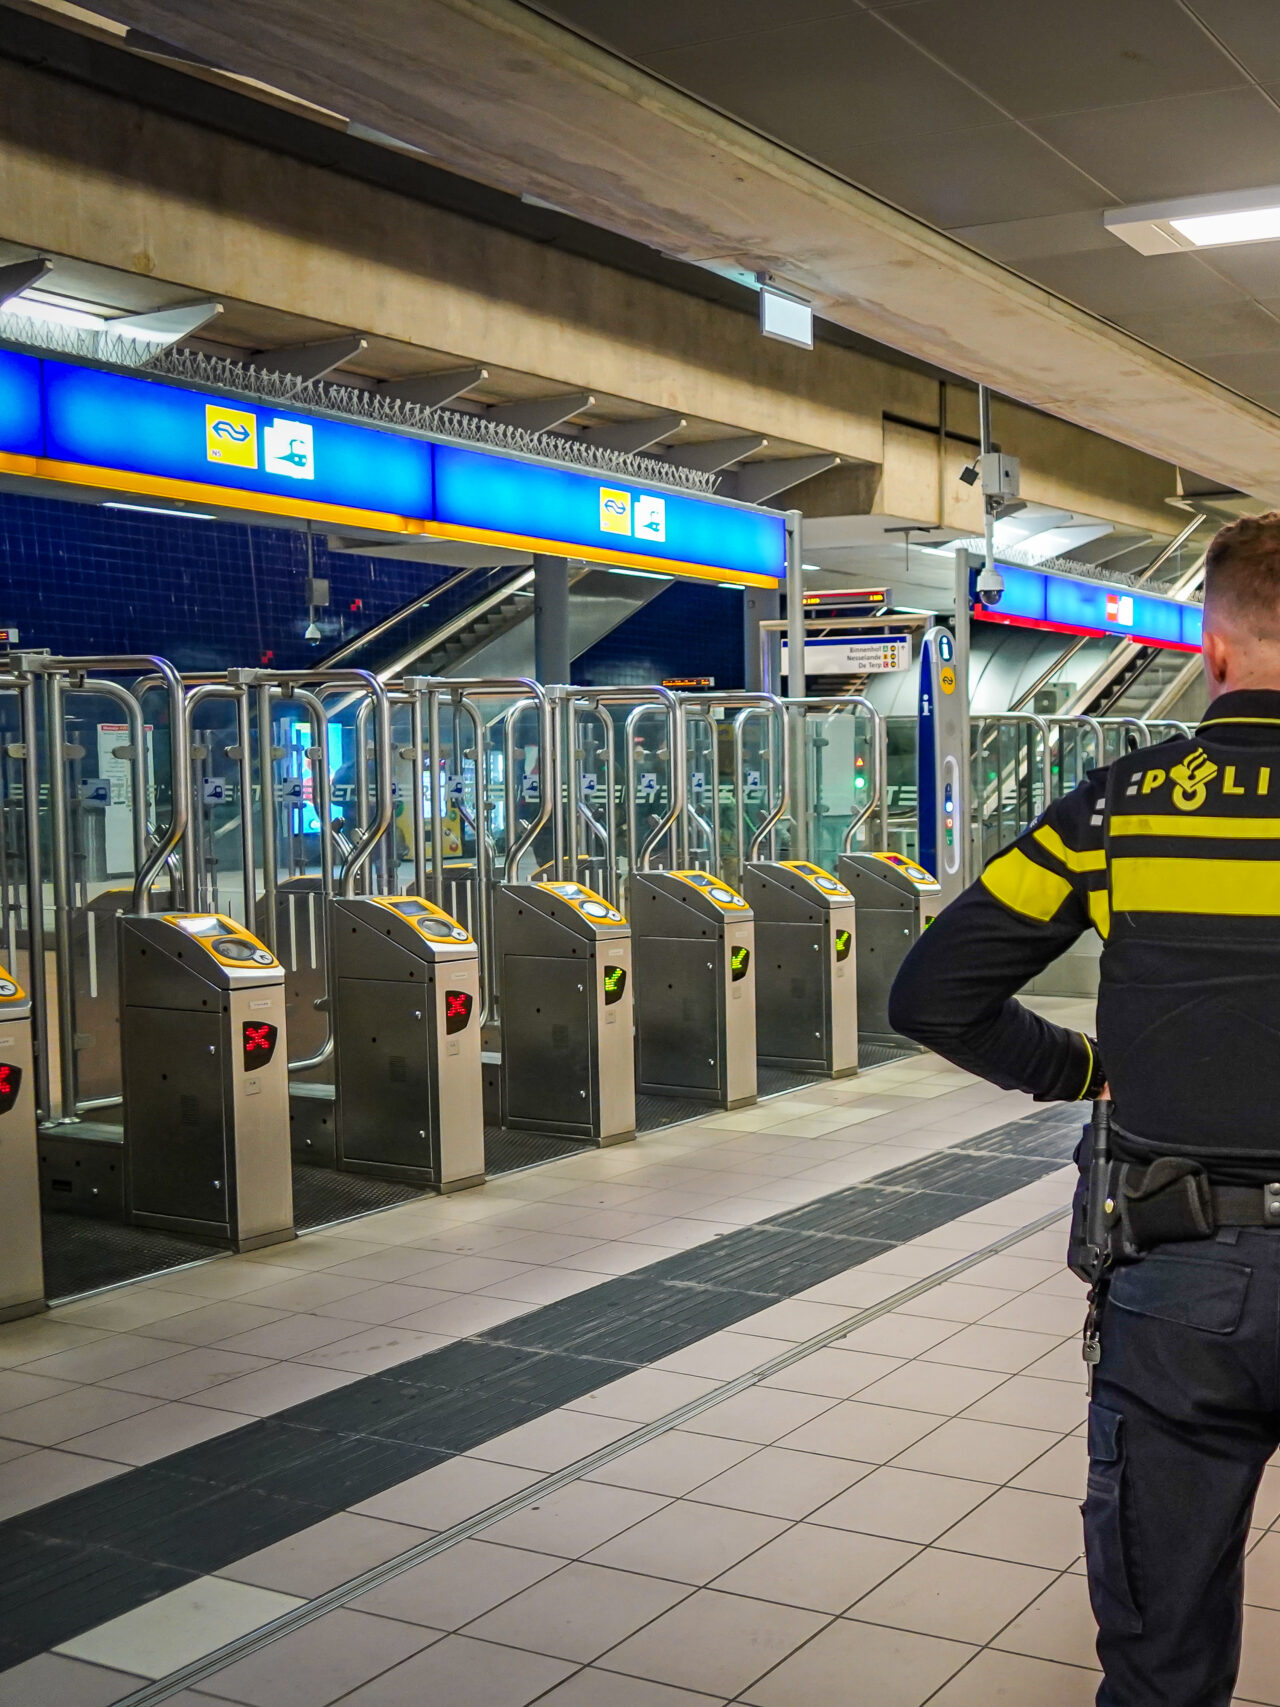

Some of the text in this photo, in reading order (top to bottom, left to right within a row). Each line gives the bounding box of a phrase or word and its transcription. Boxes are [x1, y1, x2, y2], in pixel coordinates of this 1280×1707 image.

[211, 449, 222, 457] NS
[849, 645, 882, 653] Binnenhof
[868, 661, 882, 669] Terp
